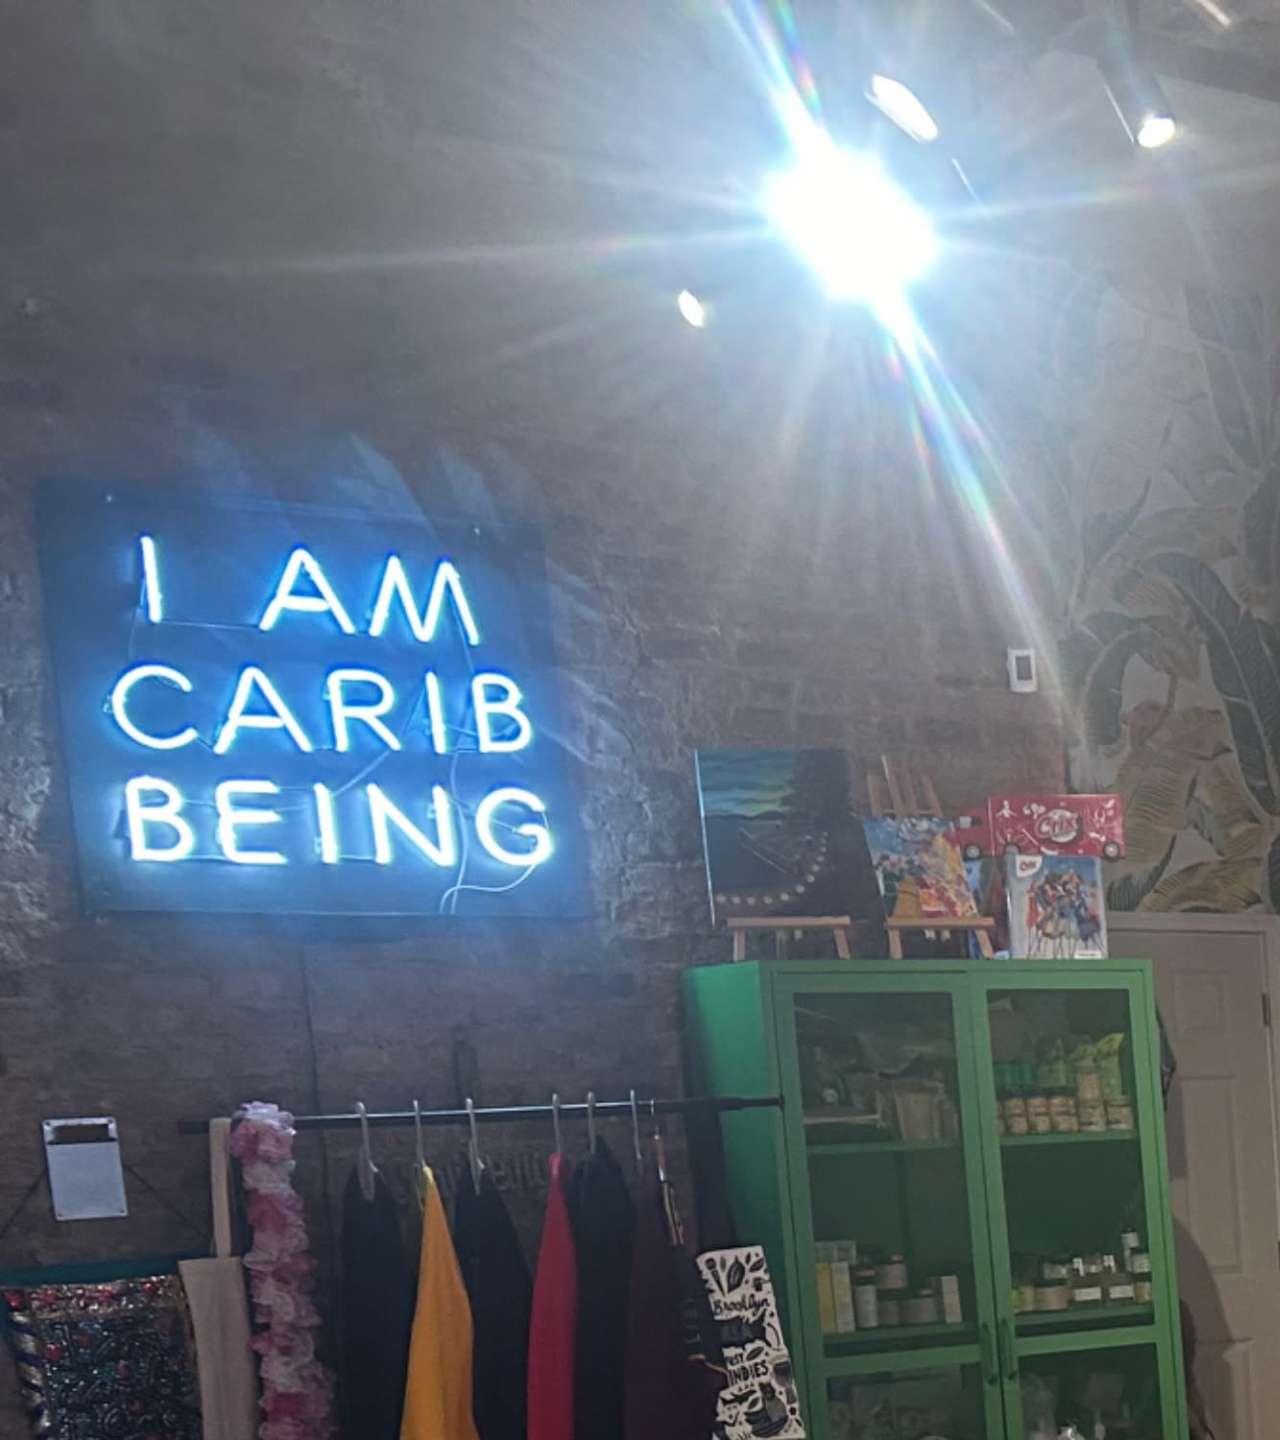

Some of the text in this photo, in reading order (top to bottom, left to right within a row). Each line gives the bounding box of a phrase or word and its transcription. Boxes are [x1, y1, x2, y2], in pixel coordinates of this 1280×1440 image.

[138, 534, 480, 645] I AM
[110, 664, 532, 755] CARIB
[125, 775, 554, 867] BEING
[729, 1359, 769, 1386] INDIES
